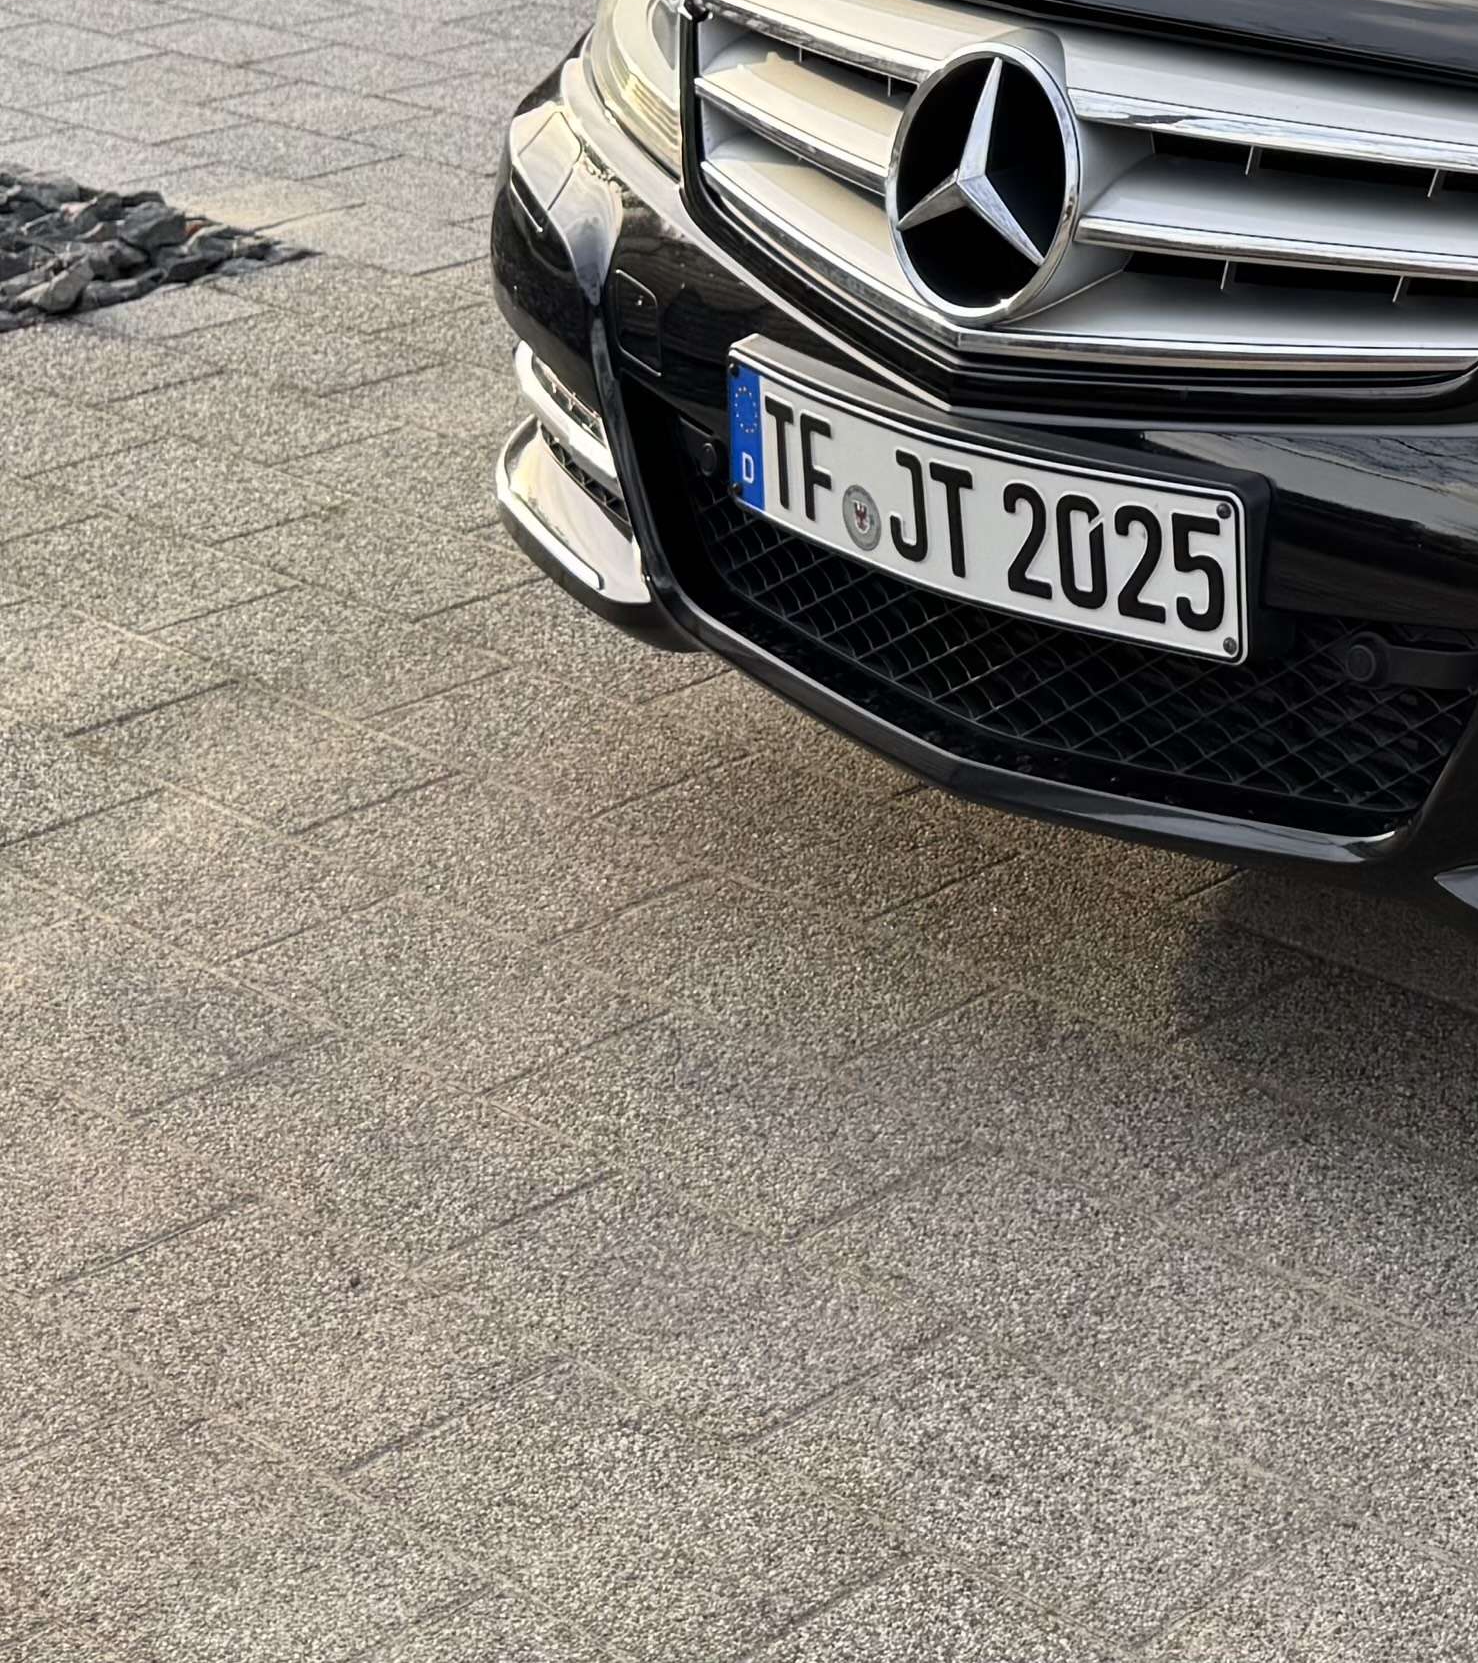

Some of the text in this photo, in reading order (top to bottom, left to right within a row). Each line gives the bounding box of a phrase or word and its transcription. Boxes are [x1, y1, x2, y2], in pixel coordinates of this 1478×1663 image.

[741, 451, 755, 484] D
[764, 395, 1226, 634] TF JT 2025
